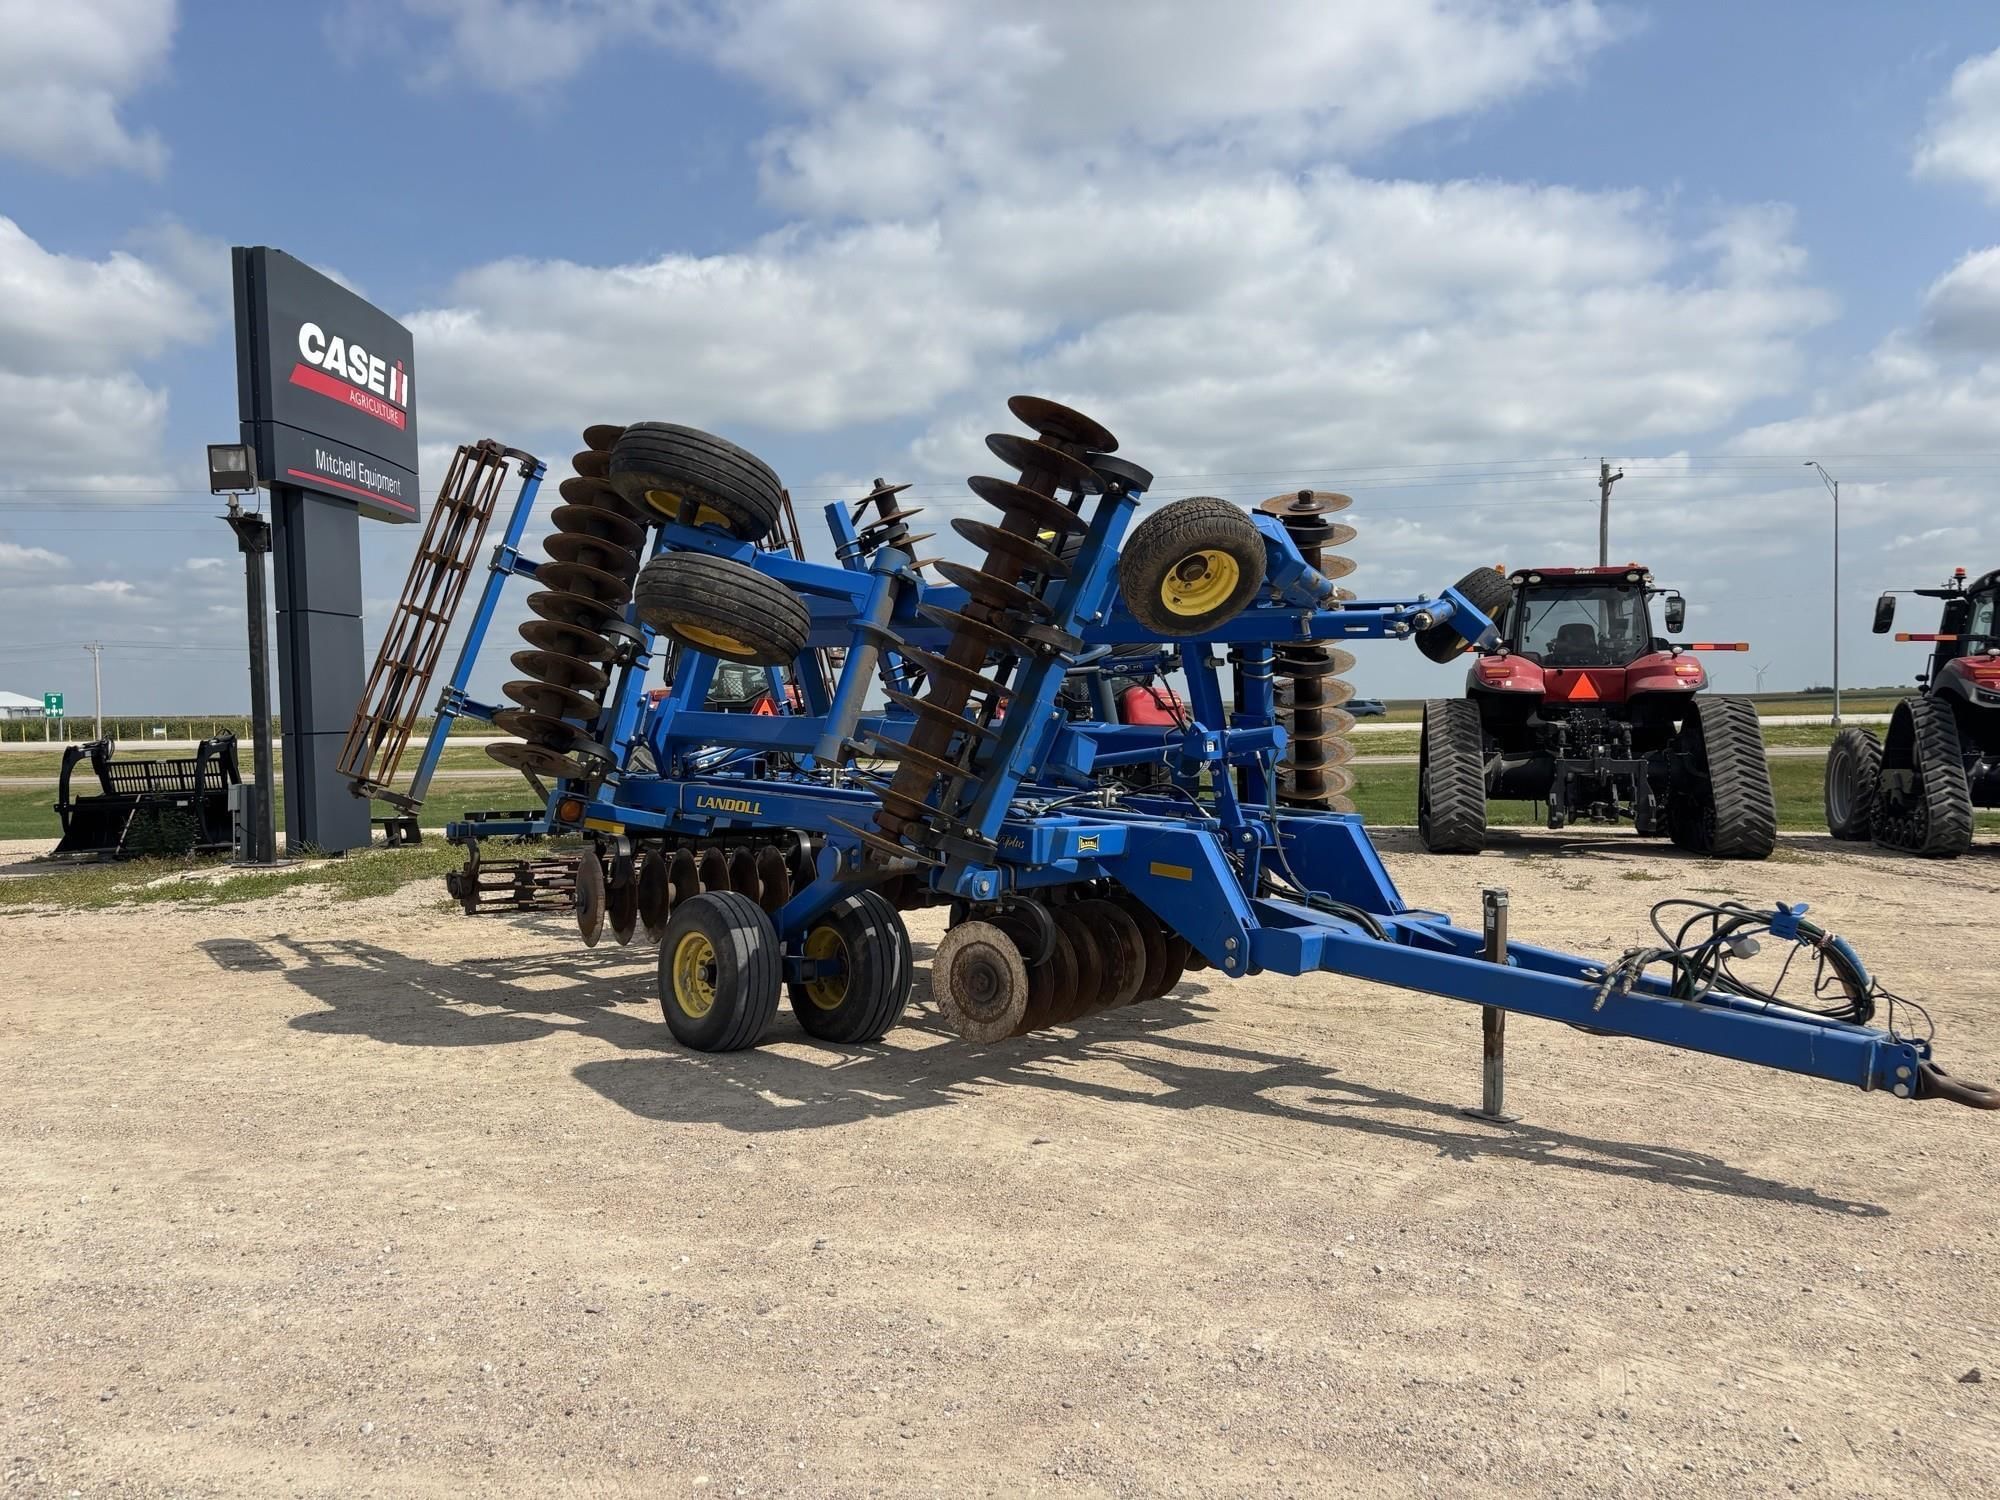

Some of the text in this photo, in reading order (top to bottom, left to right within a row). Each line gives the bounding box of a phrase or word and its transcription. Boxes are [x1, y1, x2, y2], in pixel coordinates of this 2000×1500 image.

[298, 322, 386, 395] CASE
[349, 390, 400, 424] AGRICULTURE
[315, 448, 402, 497] Mitchell Equipment
[696, 795, 762, 815] LANDOLL
